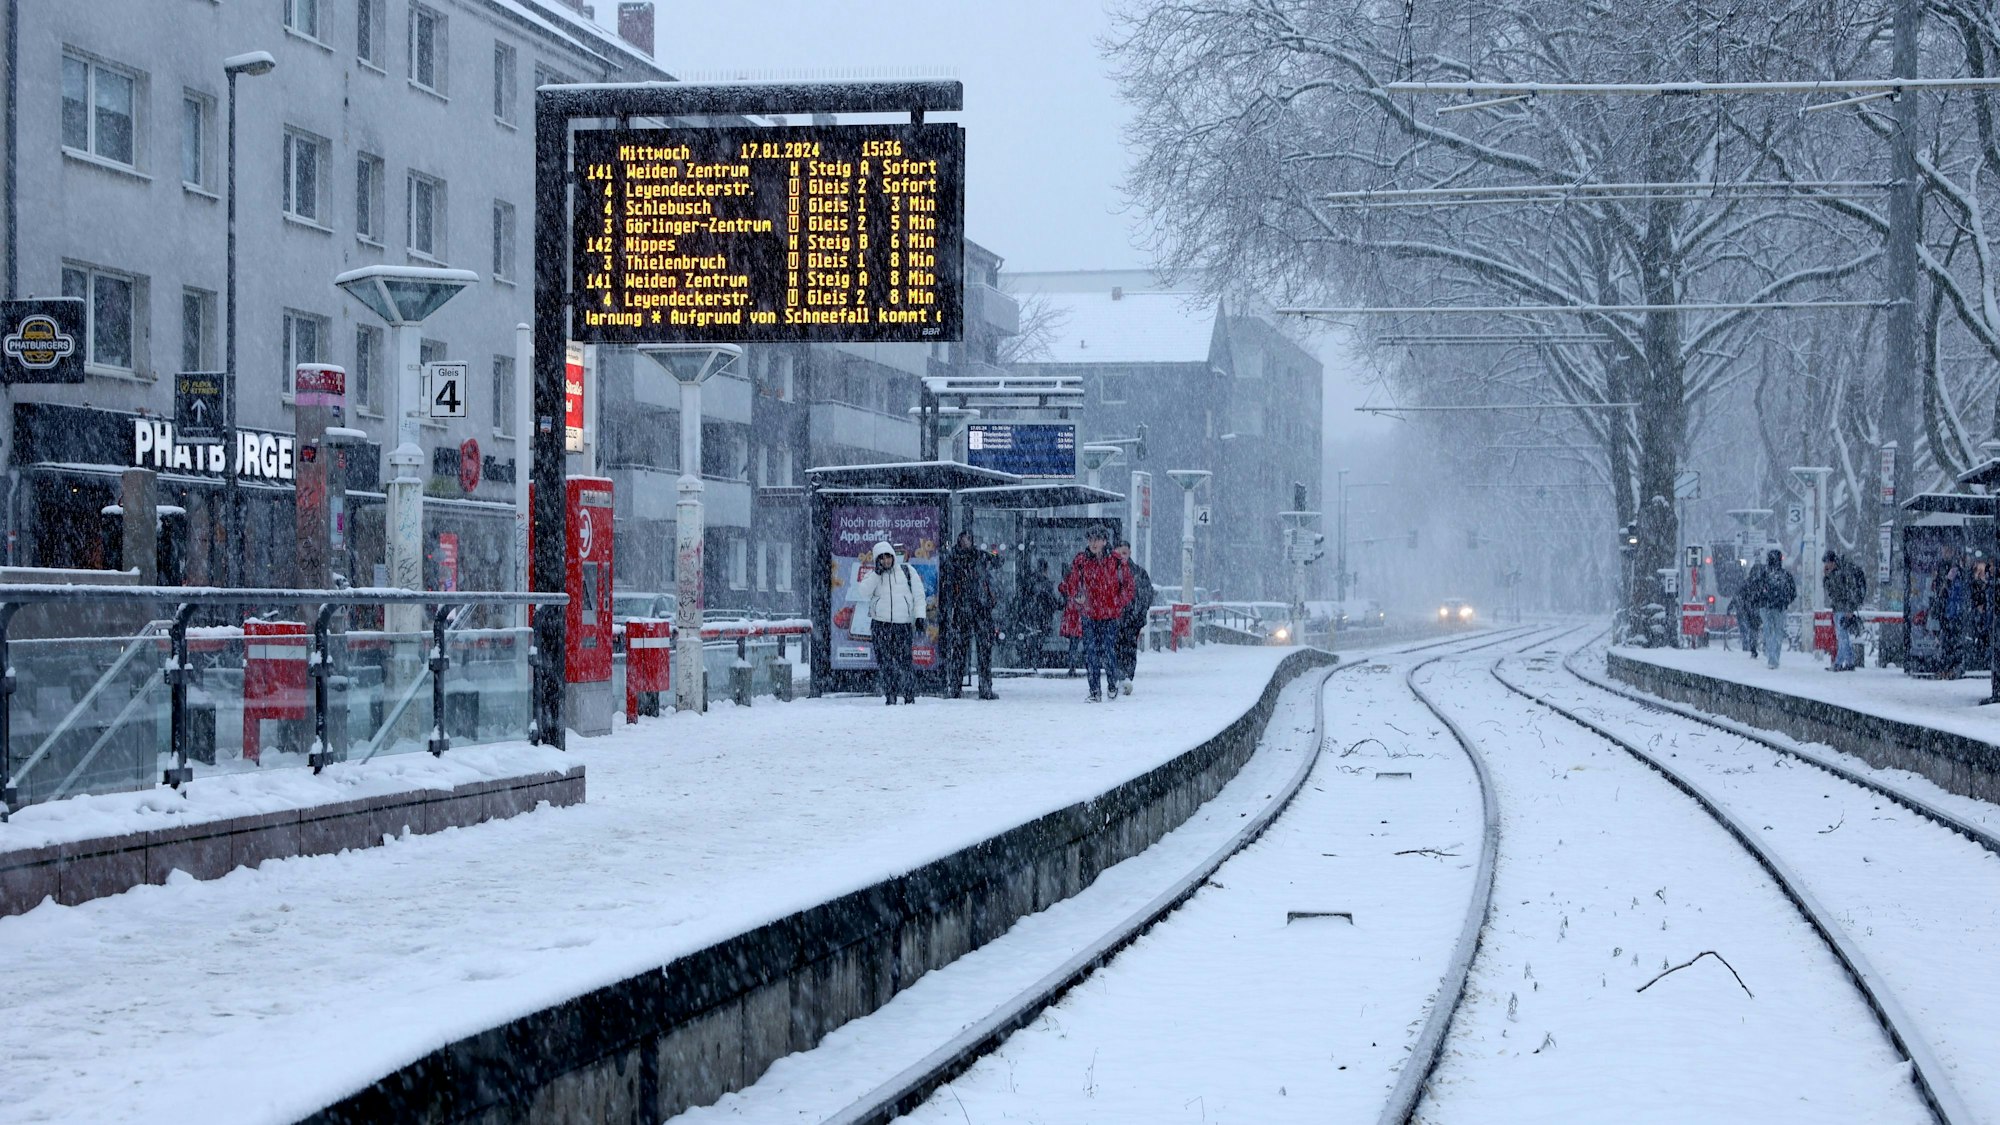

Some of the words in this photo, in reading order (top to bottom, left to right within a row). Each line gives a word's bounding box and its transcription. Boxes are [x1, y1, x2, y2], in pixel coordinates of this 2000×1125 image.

[620, 145, 689, 161] Mittwoch
[741, 142, 819, 158] 17.01.2024
[863, 141, 901, 156] 15:36
[588, 165, 612, 179] 141
[627, 164, 677, 179] Weiden
[687, 163, 749, 178] Zentrum
[790, 162, 798, 175] H
[810, 161, 851, 178] Steig
[860, 161, 869, 174] A
[883, 159, 936, 174] Sofort
[605, 183, 612, 196] 4
[626, 182, 753, 199] Leyendeckerstr.
[809, 179, 848, 194] Gleis
[859, 179, 866, 193] 2
[884, 178, 935, 193] Sofort
[605, 202, 612, 214] 4
[626, 200, 711, 215] Schlebusch
[809, 198, 848, 213] Gleis
[859, 198, 865, 212] 1
[892, 197, 899, 211] 3
[910, 197, 935, 211] Min
[604, 219, 612, 234] 3
[626, 217, 771, 235] Görlinger-Zentrum
[809, 216, 848, 231] Gleis
[859, 216, 866, 230] 2
[892, 215, 899, 230] 5
[909, 215, 934, 230] Min
[588, 237, 612, 252] 142
[626, 237, 675, 253] Nippes
[789, 235, 797, 250] H
[809, 234, 850, 251] Steig
[859, 234, 868, 249] B
[891, 234, 899, 248] 6
[909, 234, 934, 248] Min
[605, 255, 612, 270] 3
[627, 254, 725, 270] Thielenbruch
[808, 253, 847, 268] Gleis
[858, 254, 864, 267] 1
[891, 252, 899, 267] 8
[909, 252, 934, 267] Min
[588, 275, 611, 288] 141
[626, 273, 676, 288] Weiden
[686, 273, 747, 288] Zentrum
[789, 271, 797, 286] H
[808, 271, 849, 288] Steig
[859, 272, 867, 285] A
[891, 270, 899, 285] 8
[909, 271, 934, 285] Min
[604, 292, 611, 305] 4
[625, 291, 753, 309] Leyendeckerstr.
[808, 290, 847, 305] Gleis
[857, 289, 864, 304] 2
[890, 289, 899, 304] 8
[909, 289, 933, 304] Min
[586, 312, 642, 327] arnung
[671, 309, 740, 326] Aufgrund
[750, 312, 776, 323] von
[786, 308, 868, 323] Schneefall
[879, 309, 926, 322] kommt
[9, 341, 69, 350] PHATBURGERS
[438, 368, 459, 377] Gleis
[435, 380, 461, 413] 4
[840, 517, 864, 528] Noch
[867, 517, 891, 528] mehr
[895, 516, 930, 530] sparen?
[1198, 511, 1209, 524] 4
[1790, 509, 1801, 523] 3
[840, 530, 860, 543] App
[862, 530, 892, 541] dafür!
[1687, 547, 1702, 566] H
[1667, 578, 1674, 591] F
